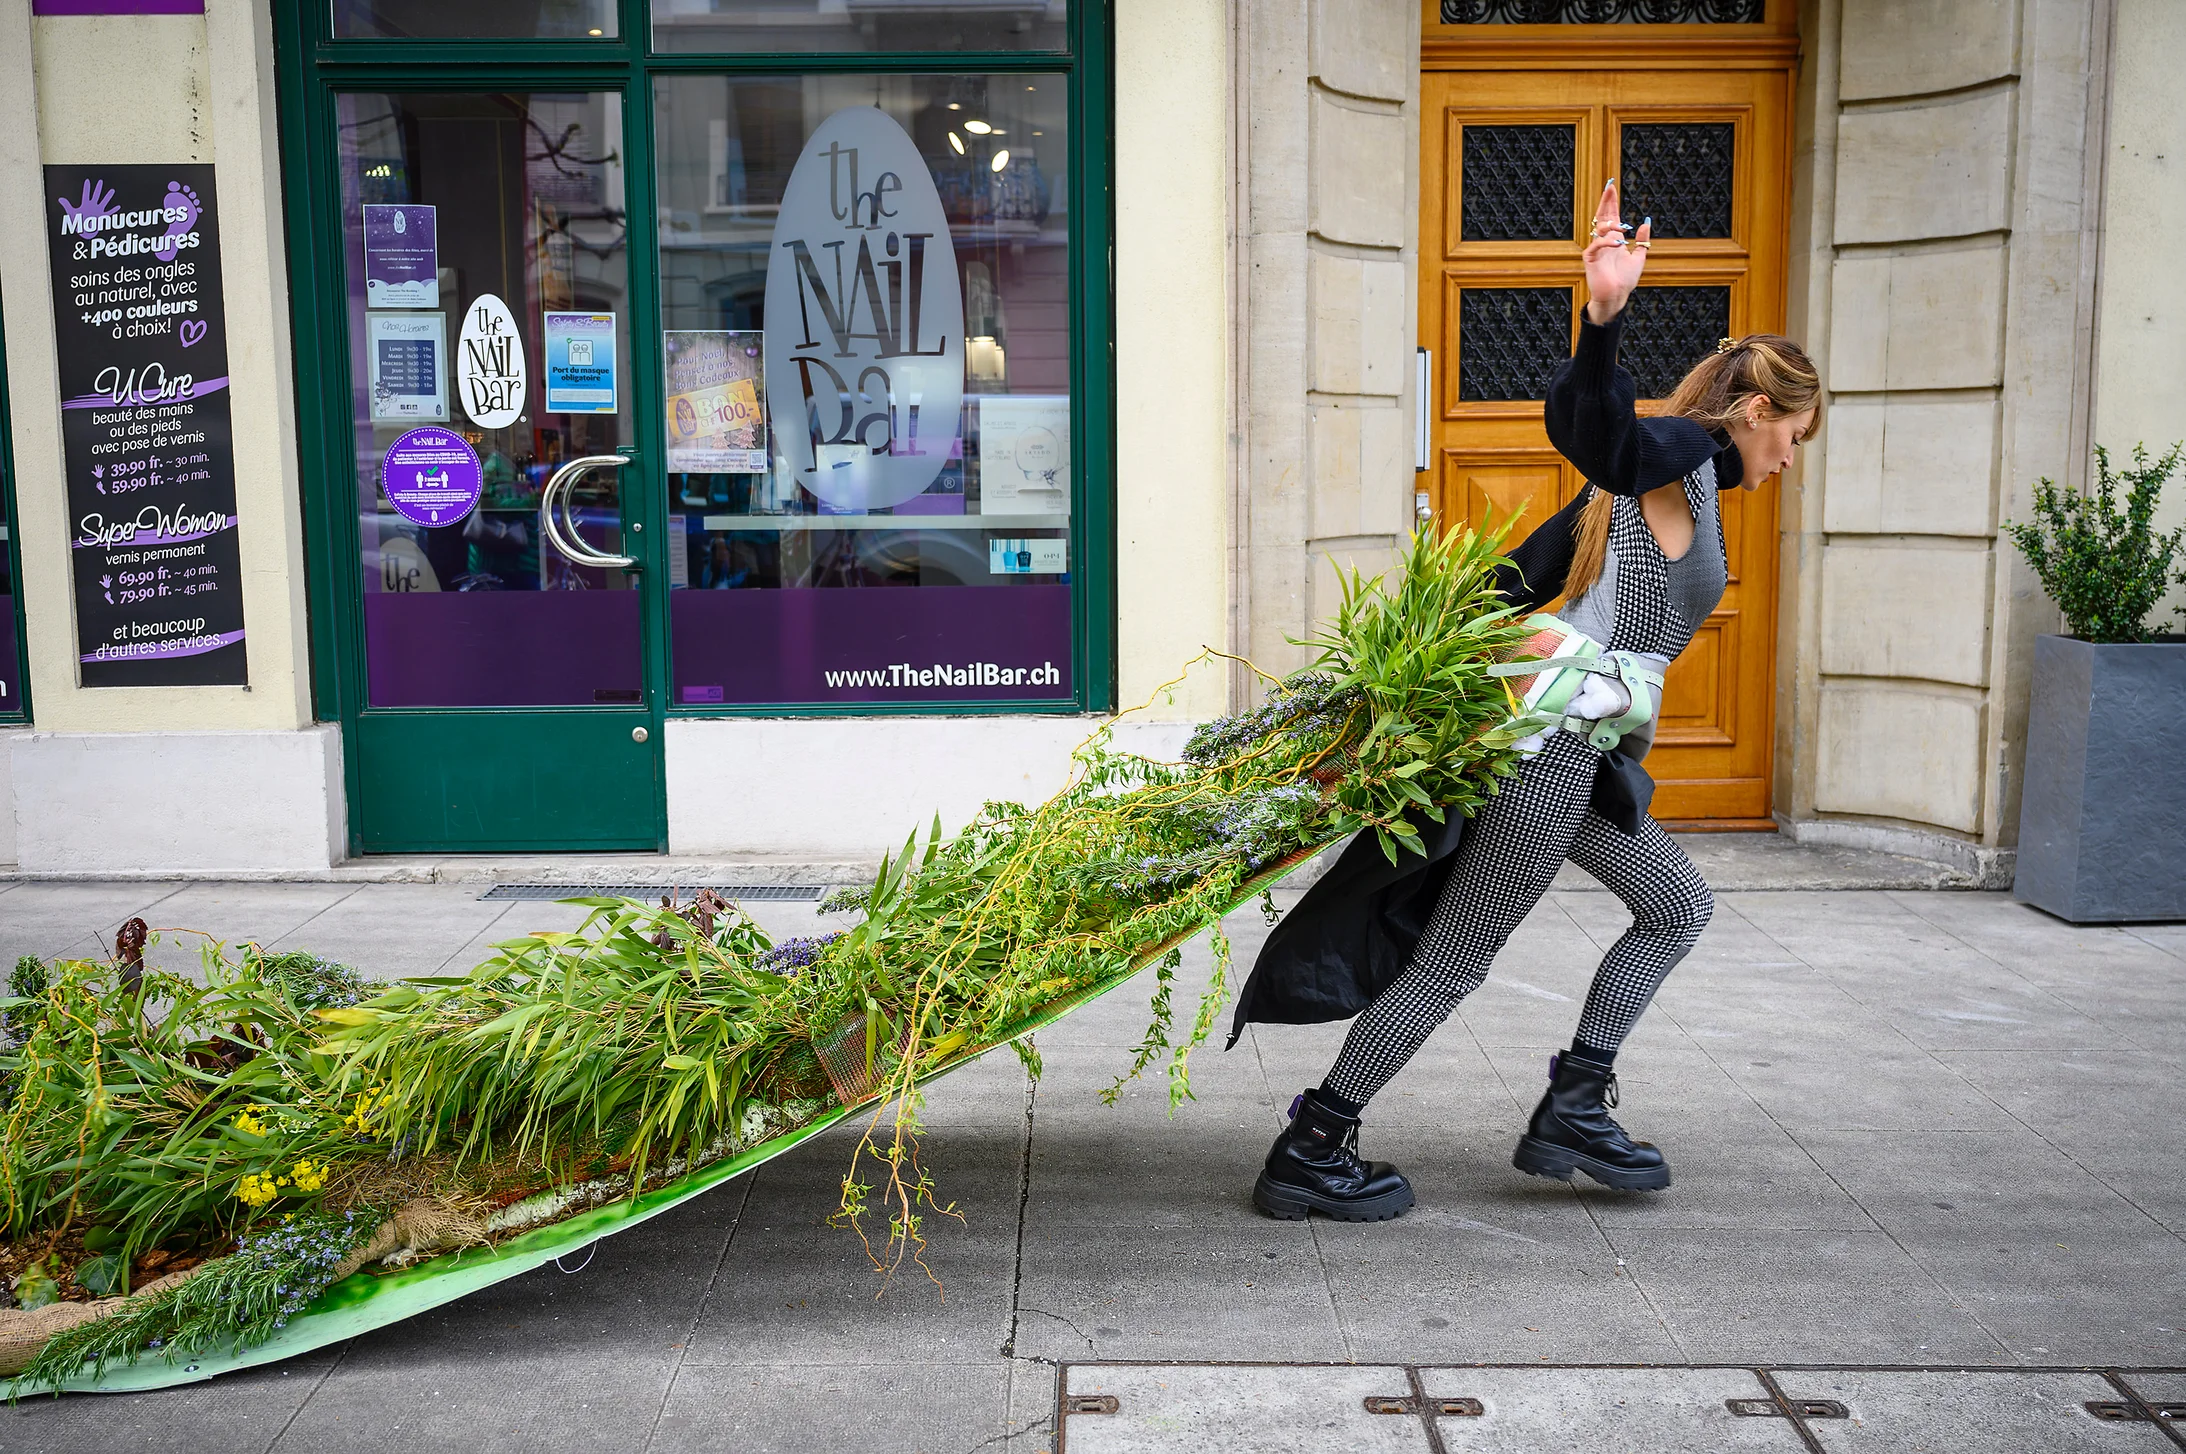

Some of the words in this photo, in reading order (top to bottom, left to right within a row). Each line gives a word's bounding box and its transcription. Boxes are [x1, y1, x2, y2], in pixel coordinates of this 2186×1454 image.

[818, 141, 902, 230] the
[61, 205, 188, 235] Manucures
[73, 241, 88, 260] &
[91, 231, 200, 259] Pédicures
[70, 271, 109, 288] soins
[114, 266, 141, 283] des
[145, 260, 195, 282] ongles
[75, 292, 94, 306] au
[99, 281, 156, 303] naturel,
[161, 280, 197, 296] avec
[81, 308, 122, 327] +400
[127, 299, 198, 318] couleurs
[475, 306, 503, 336] the
[112, 323, 122, 339] à
[127, 318, 172, 337] choix!
[580, 367, 610, 375] masque
[466, 377, 521, 418] Bar
[93, 408, 133, 425] beauté
[136, 406, 156, 420] des
[159, 403, 194, 417] mains
[110, 426, 125, 438] ou
[128, 422, 148, 435] des
[151, 418, 182, 434] pieds
[91, 442, 119, 455] avec
[122, 439, 150, 454] pose
[153, 435, 168, 450] de
[170, 431, 205, 446] vernis
[111, 461, 146, 478] 39.90
[149, 456, 163, 470] fr.
[175, 458, 187, 468] 30
[190, 452, 210, 465] min.
[112, 479, 147, 495] 59.90
[150, 473, 164, 487] fr.
[176, 475, 188, 485] 40
[191, 469, 210, 481] min.
[79, 513, 137, 550] Super
[137, 503, 228, 539] Woman
[106, 551, 140, 566] vernis
[143, 544, 205, 564] permanent
[118, 571, 154, 587] 69.90
[157, 566, 172, 580] fr.
[184, 568, 196, 579] 40
[199, 563, 218, 575] min.
[120, 589, 155, 605] 79.90
[158, 584, 172, 596] fr.
[184, 585, 196, 596] 45
[199, 580, 218, 592] min.
[113, 626, 128, 640] et
[132, 617, 205, 637] beaucoup
[96, 641, 156, 660] d'autres
[825, 661, 1060, 688] www.TheNailBar.ch
